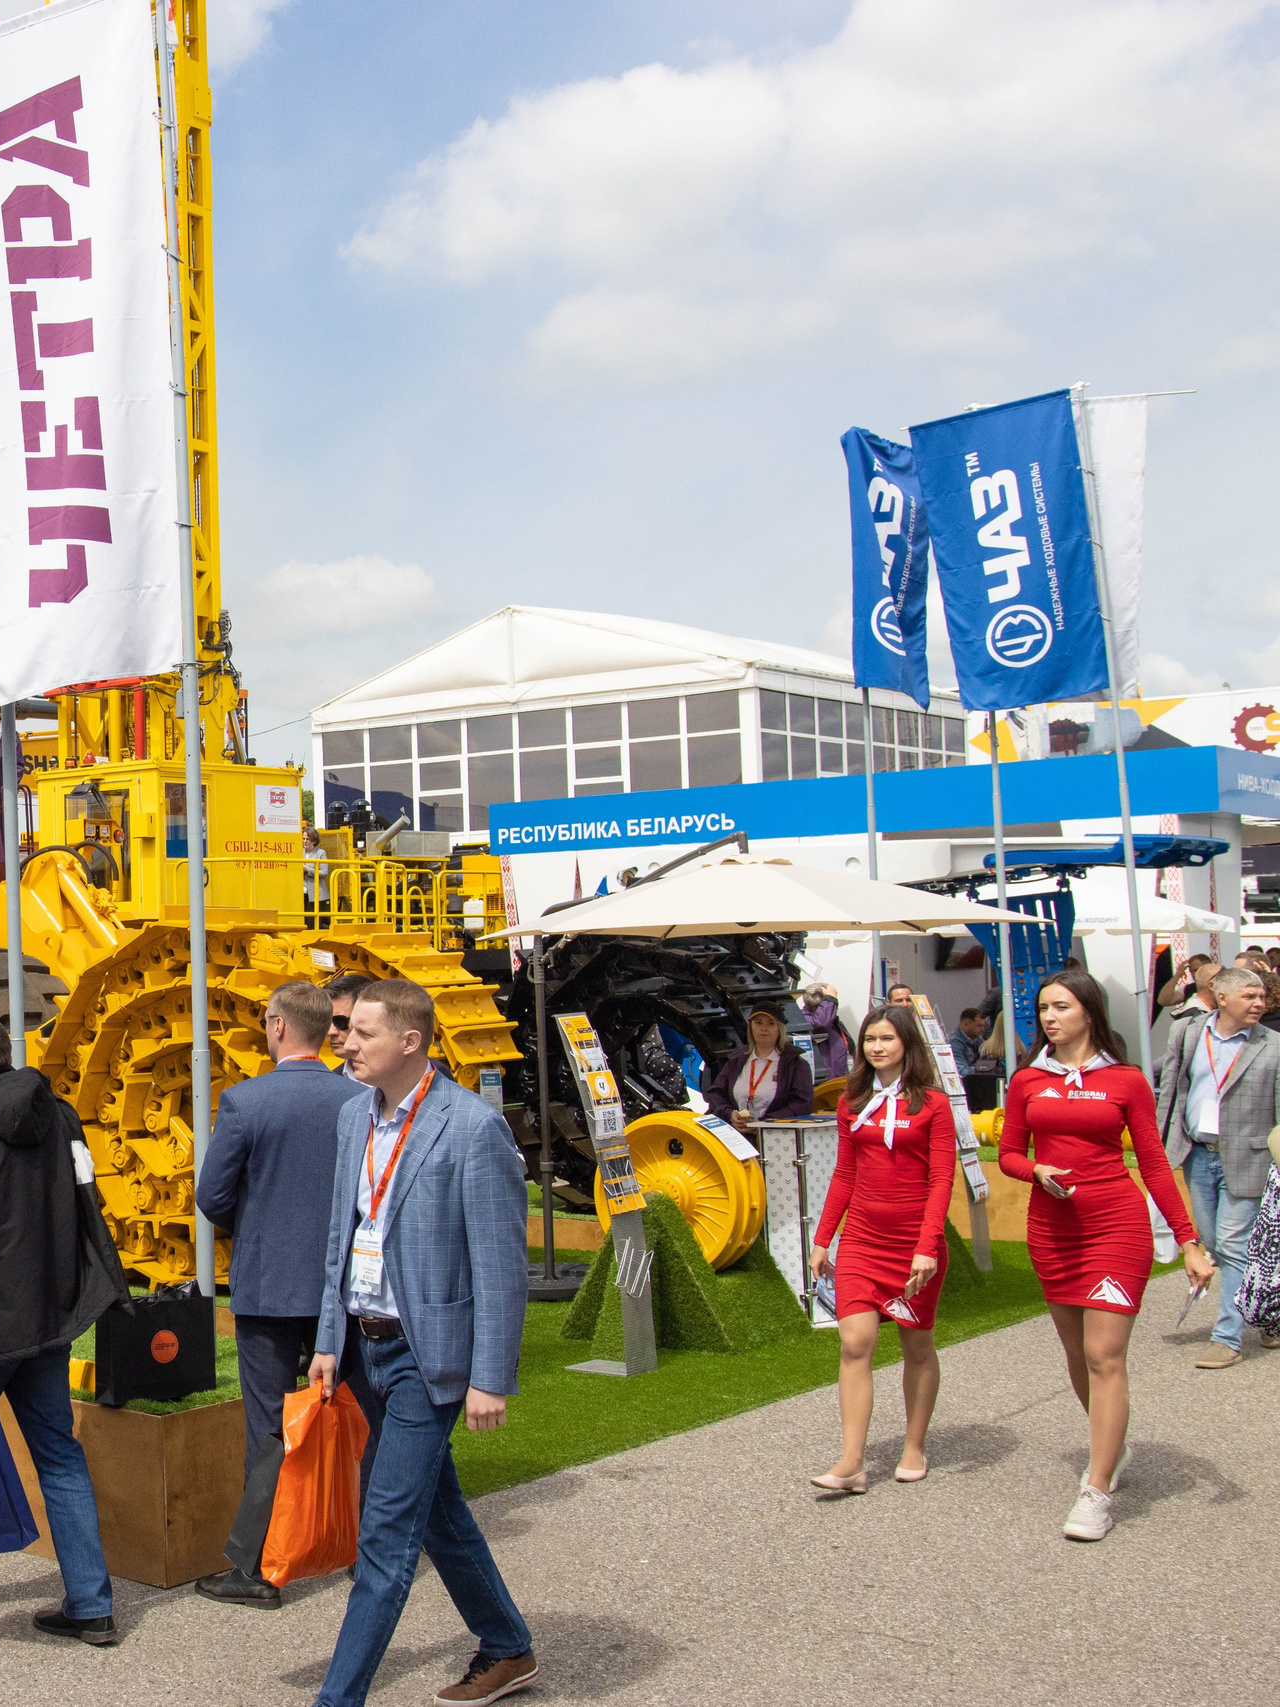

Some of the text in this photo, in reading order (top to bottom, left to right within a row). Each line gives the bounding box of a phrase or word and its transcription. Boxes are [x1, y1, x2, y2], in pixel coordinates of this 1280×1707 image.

[1029, 462, 1064, 631] НАДЕЖНЫЕ ХОДОВЫЕ СИСТЕМЫ
[498, 812, 736, 845] РЕСПУБЛИКА БЕЛАРУСЬ
[225, 840, 295, 855] СБШ-215-48ДГ
